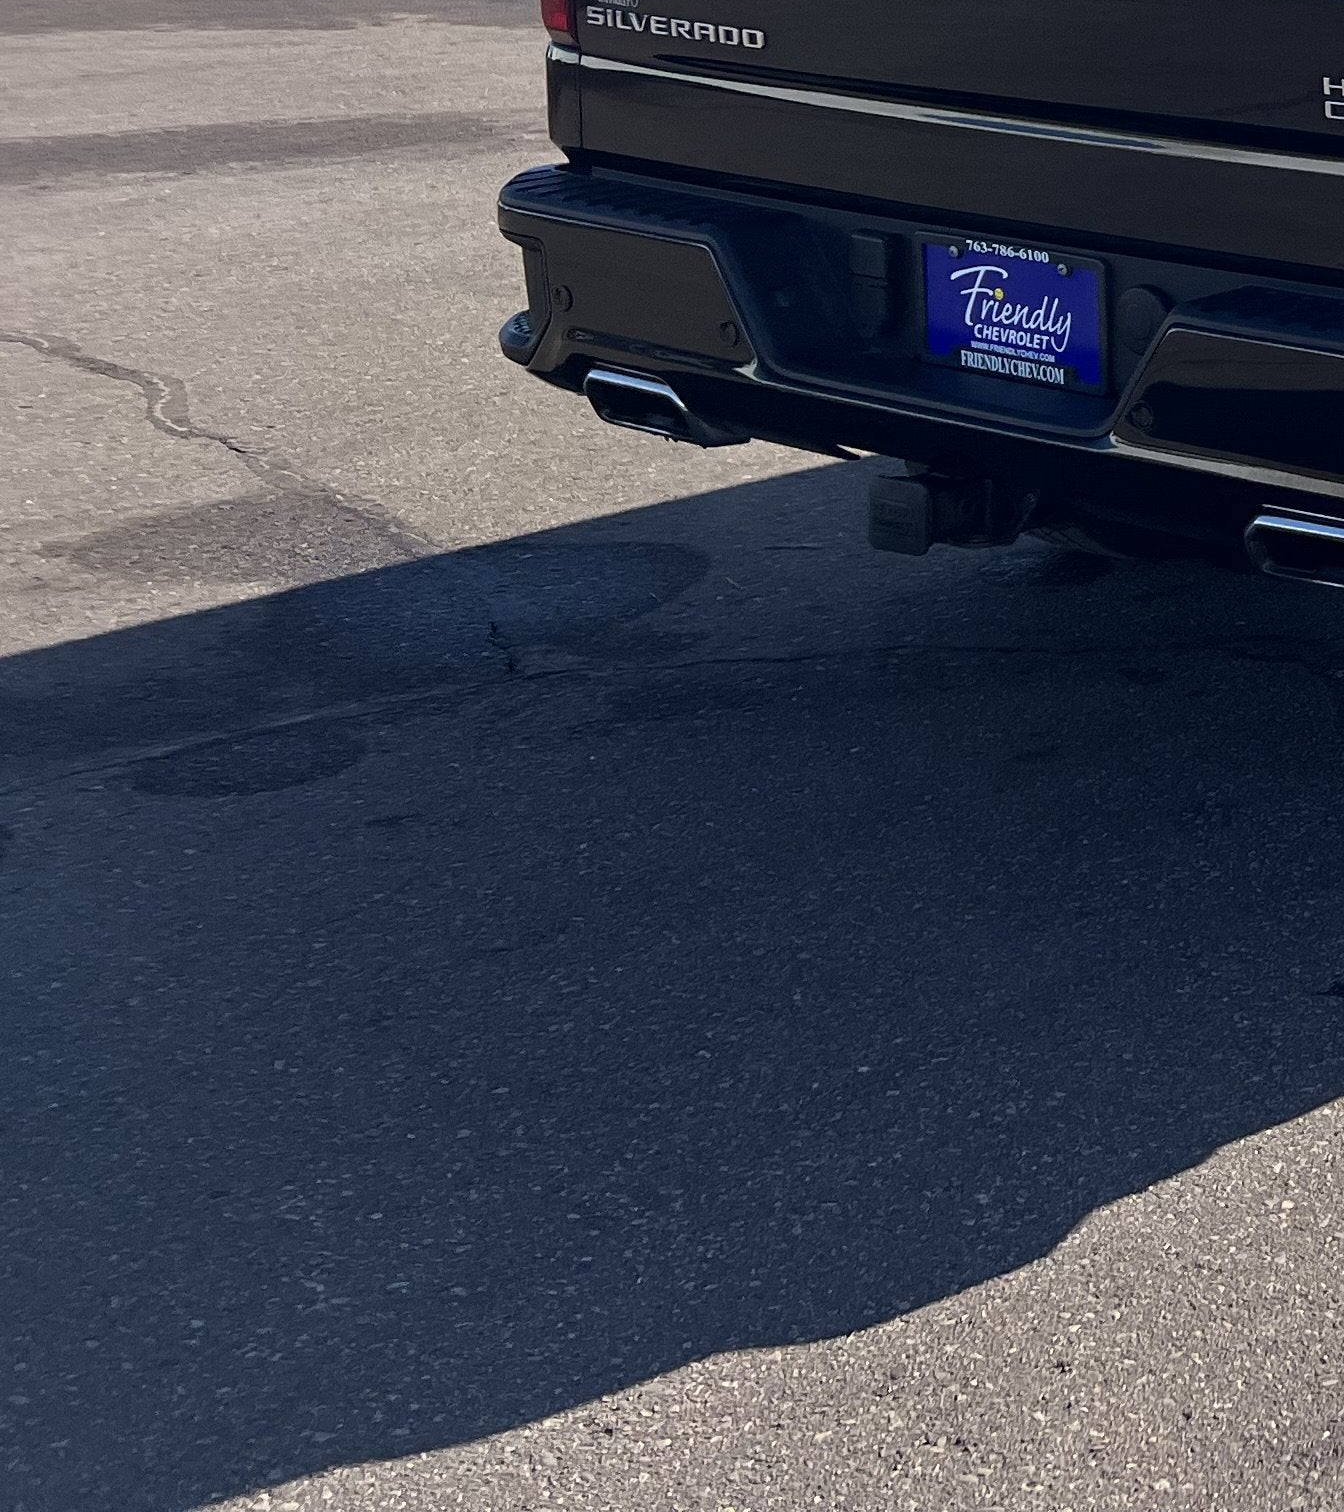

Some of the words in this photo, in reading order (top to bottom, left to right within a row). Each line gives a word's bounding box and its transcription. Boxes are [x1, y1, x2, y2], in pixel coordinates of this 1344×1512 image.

[586, 5, 766, 48] SILVERADO
[965, 239, 1050, 263] 763-786-6100
[950, 265, 1072, 352] Friendly
[973, 323, 1050, 350] CHEVROLET
[960, 349, 1065, 385] FRIENDLYCHEV.COM
